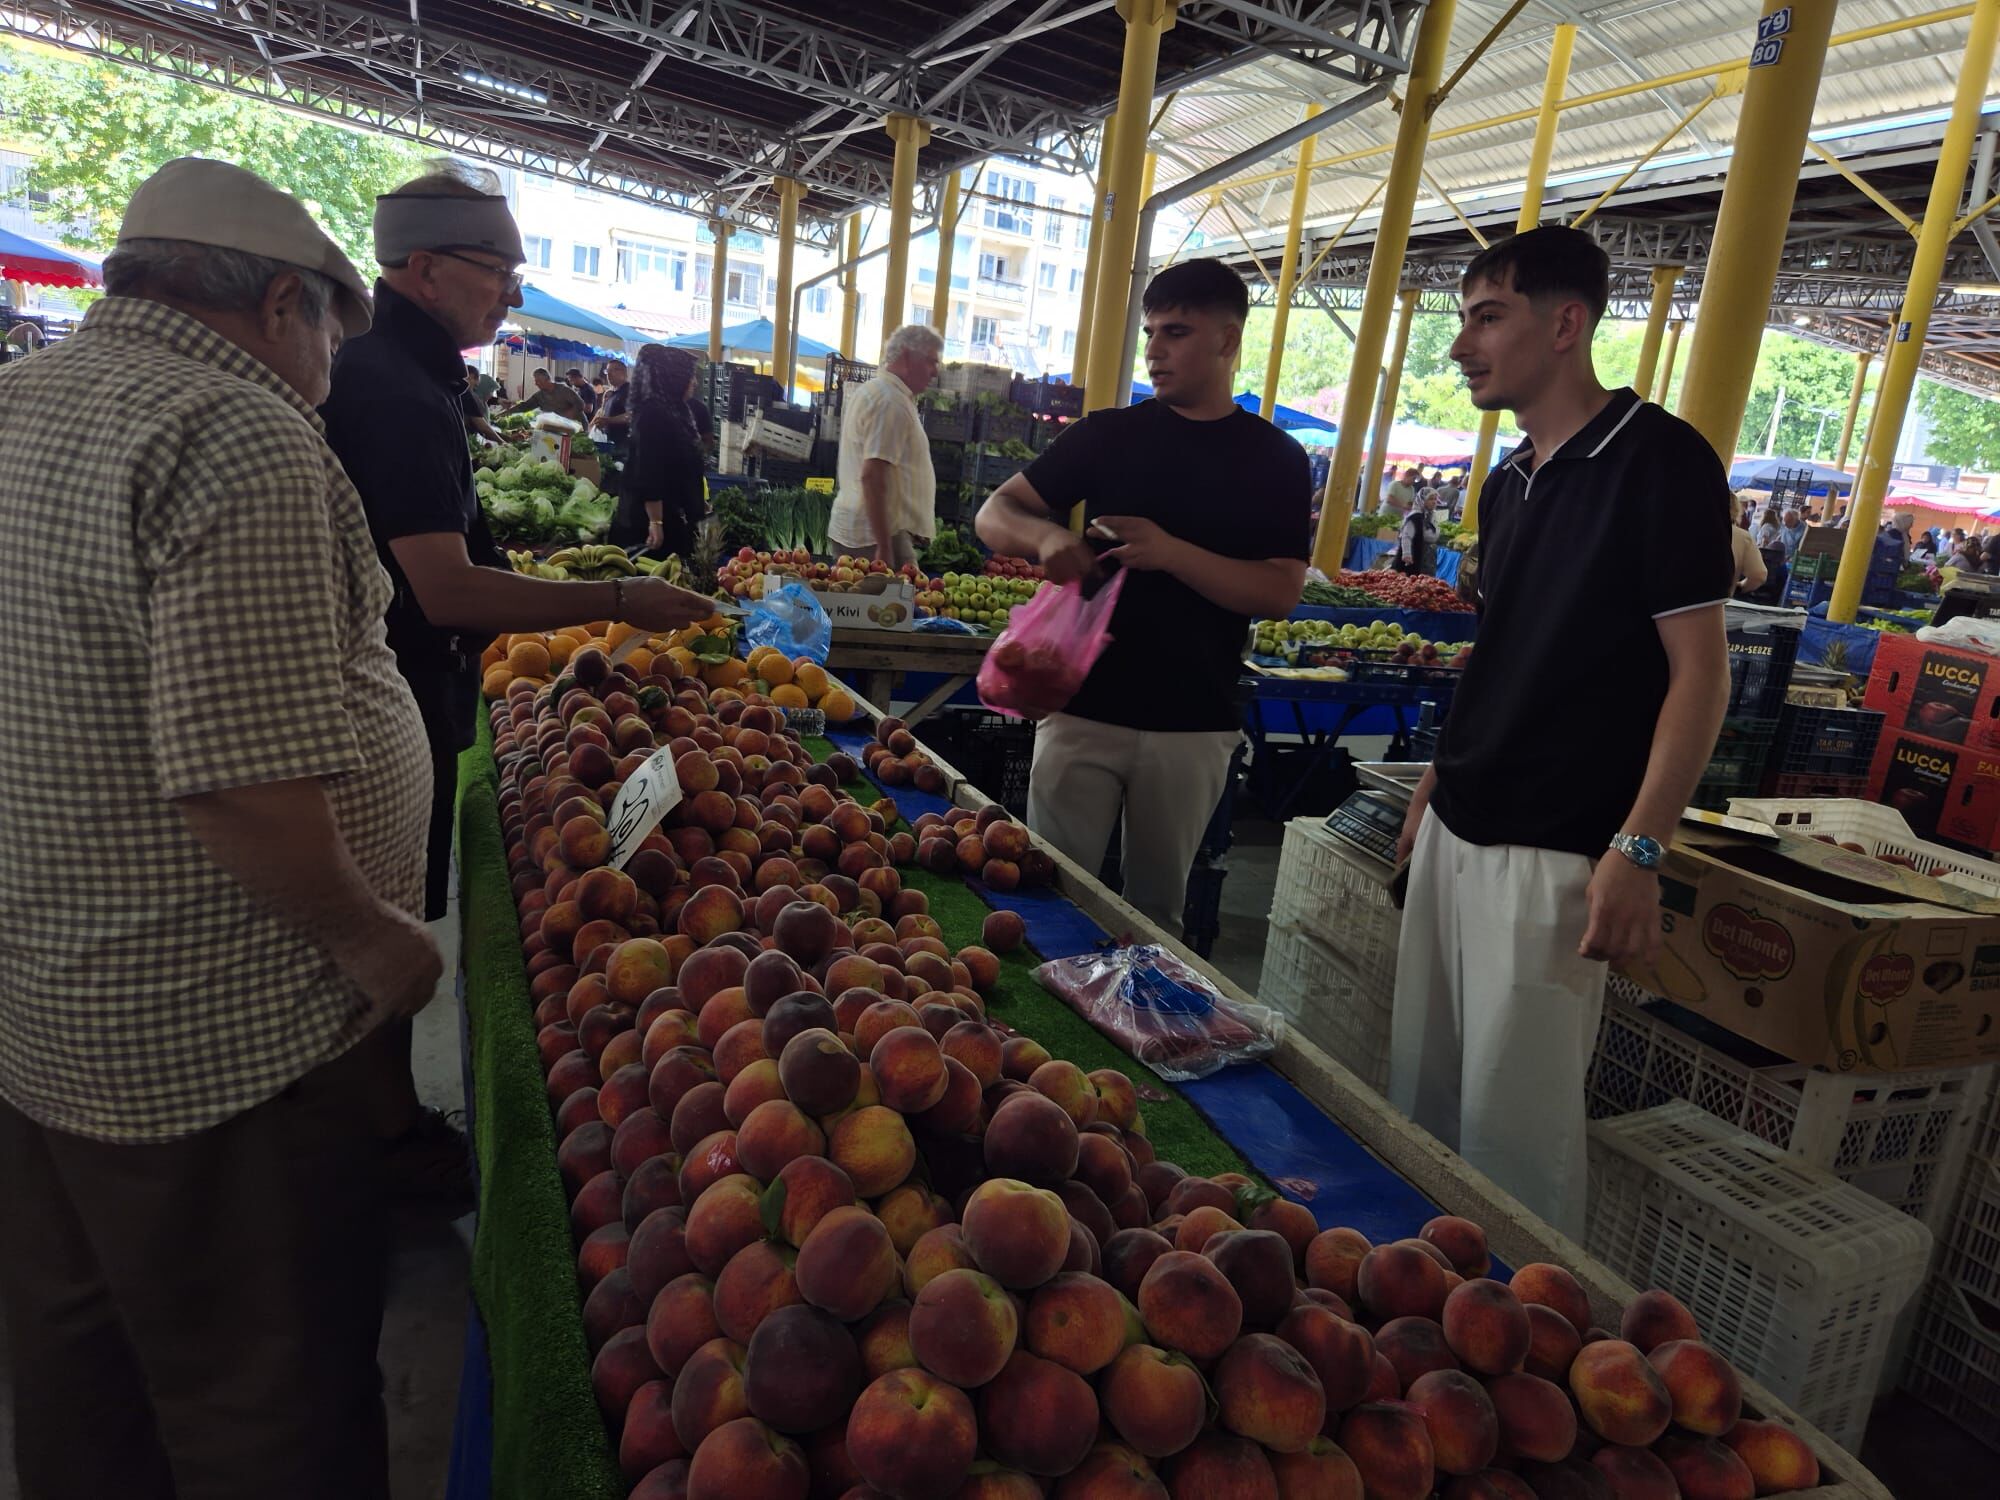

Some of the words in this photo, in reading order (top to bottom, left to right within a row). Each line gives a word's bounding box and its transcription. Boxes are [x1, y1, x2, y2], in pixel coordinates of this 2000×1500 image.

[1760, 14, 1787, 37] 79
[1752, 44, 1776, 63] 80
[836, 605, 860, 618] Kivi
[1924, 661, 1981, 687] LUCCA
[1896, 748, 1951, 775] LUCCA
[1712, 916, 1737, 943] Del
[1737, 926, 1788, 963] Monte
